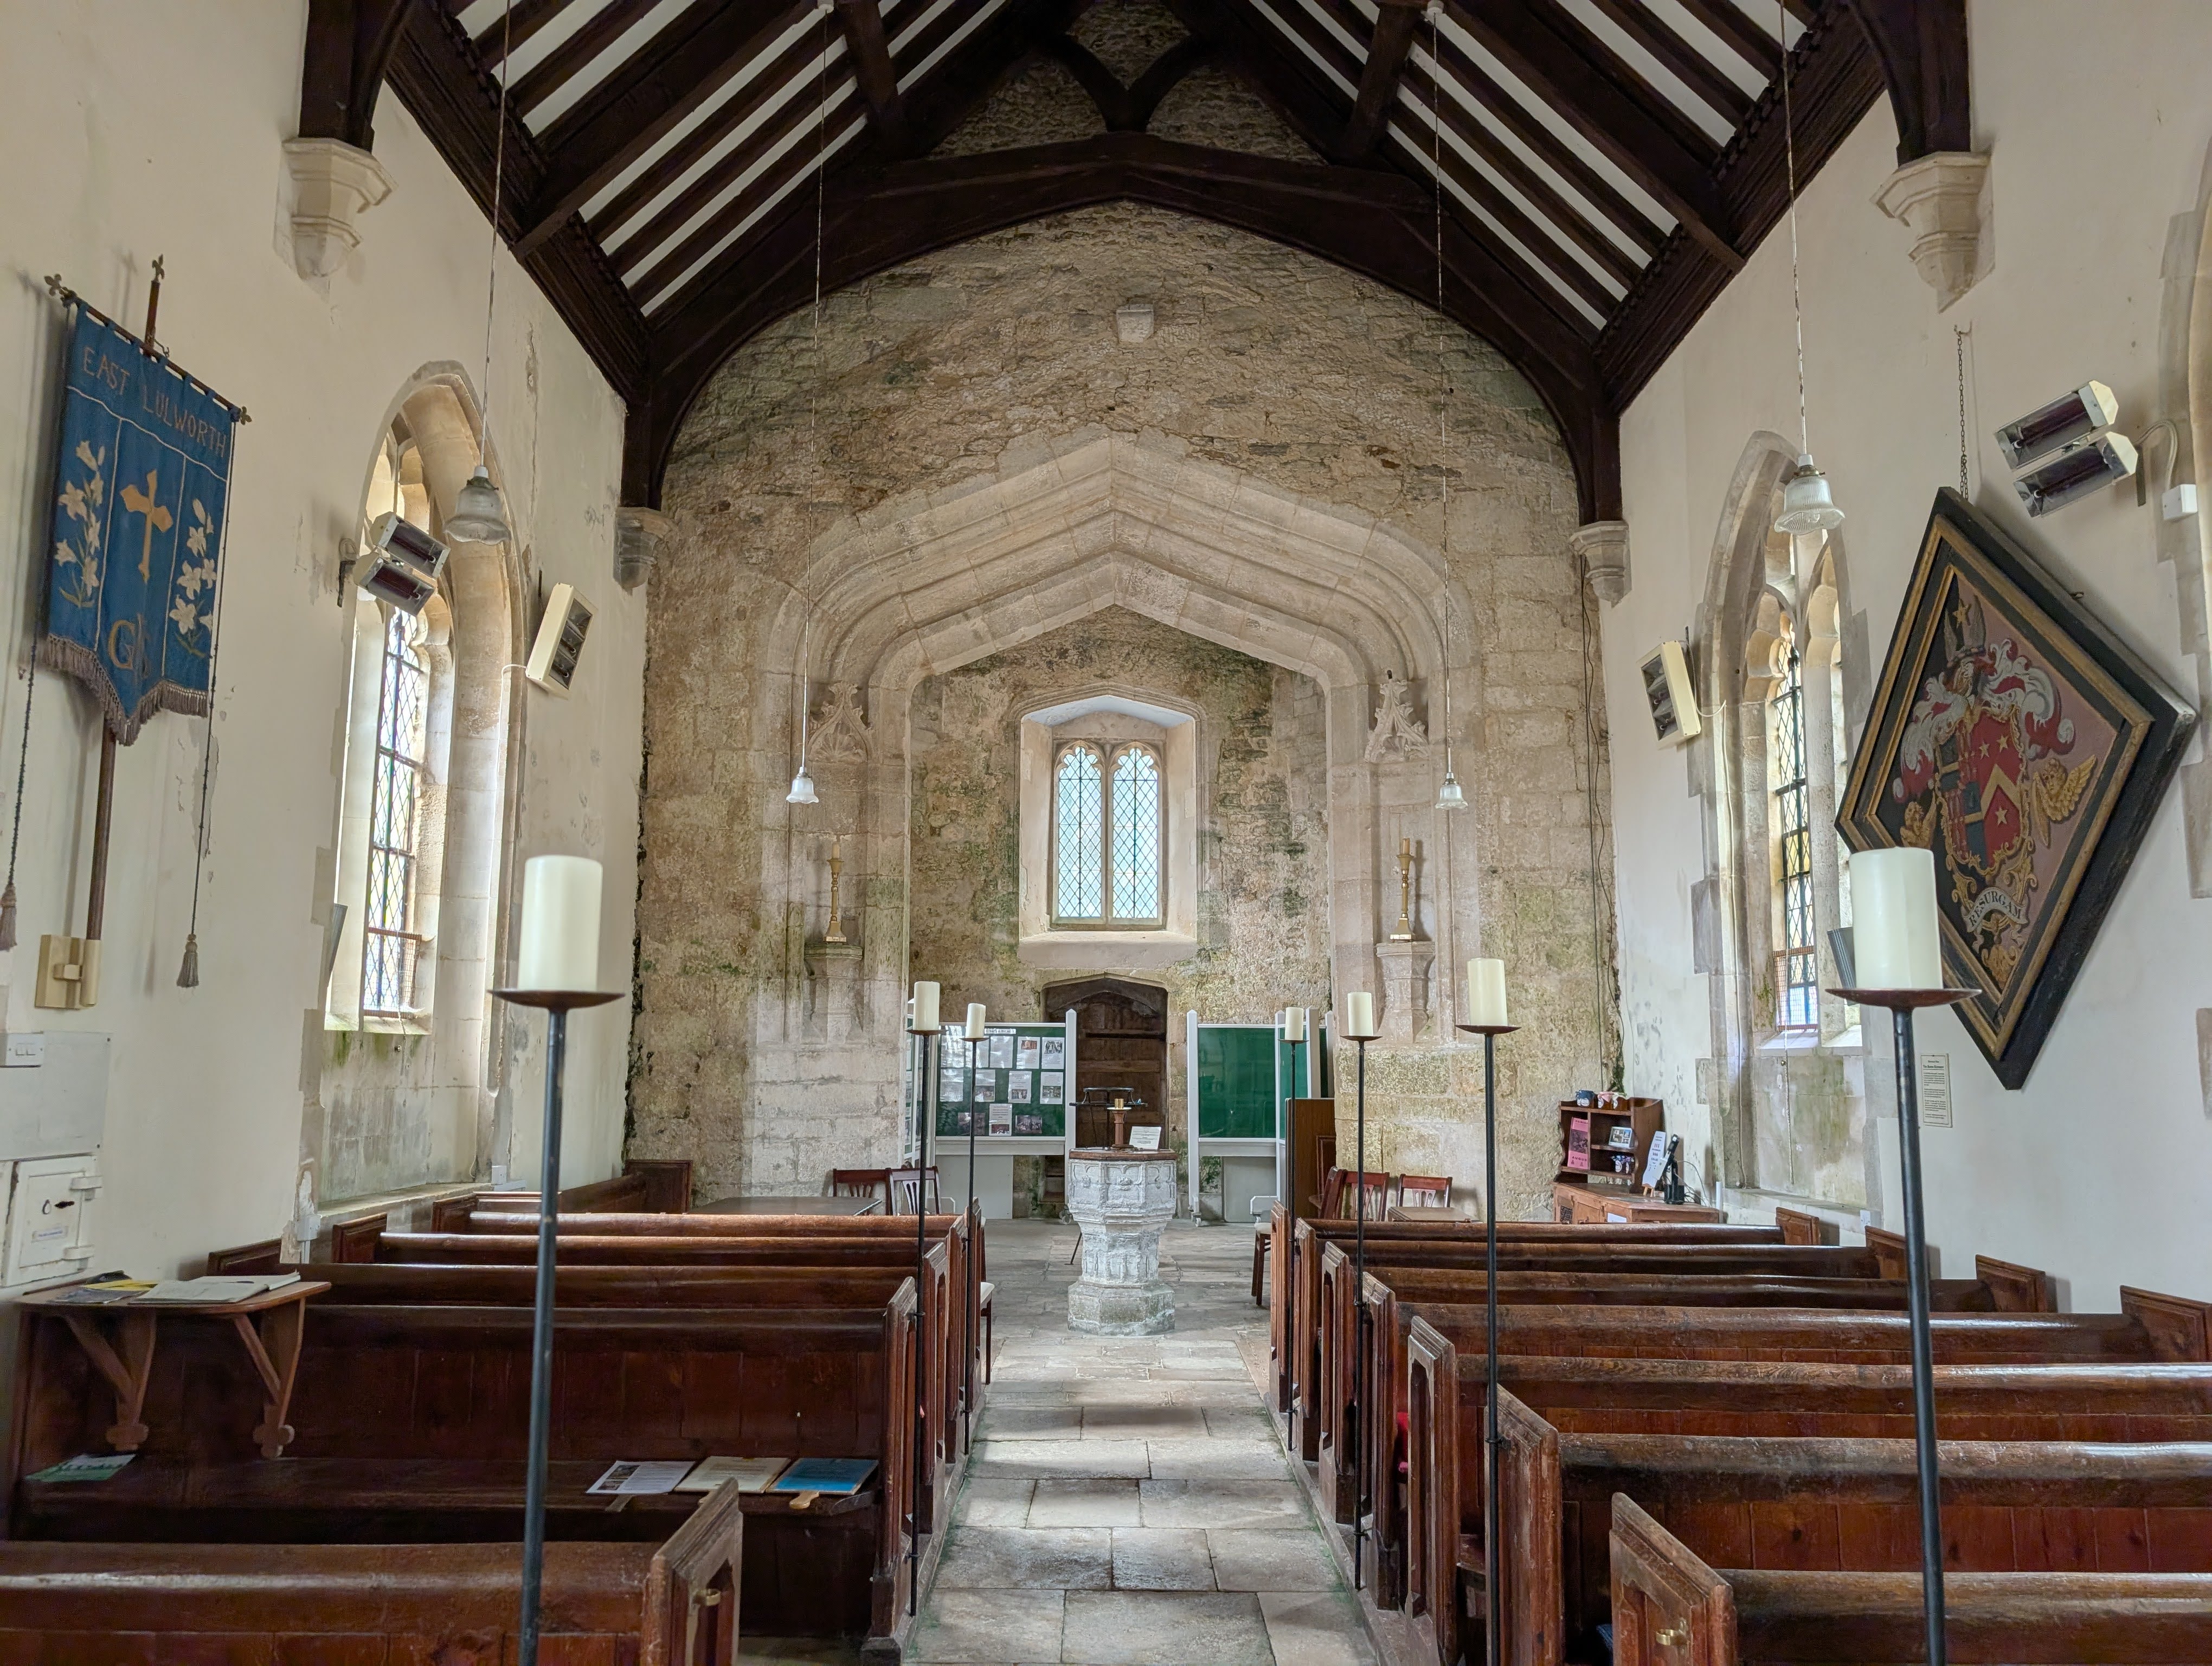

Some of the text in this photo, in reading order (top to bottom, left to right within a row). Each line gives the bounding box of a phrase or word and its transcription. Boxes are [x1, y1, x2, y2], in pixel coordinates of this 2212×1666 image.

[83, 347, 227, 458] EAST LULWORTH
[1969, 890, 2021, 927] RESURGAM
